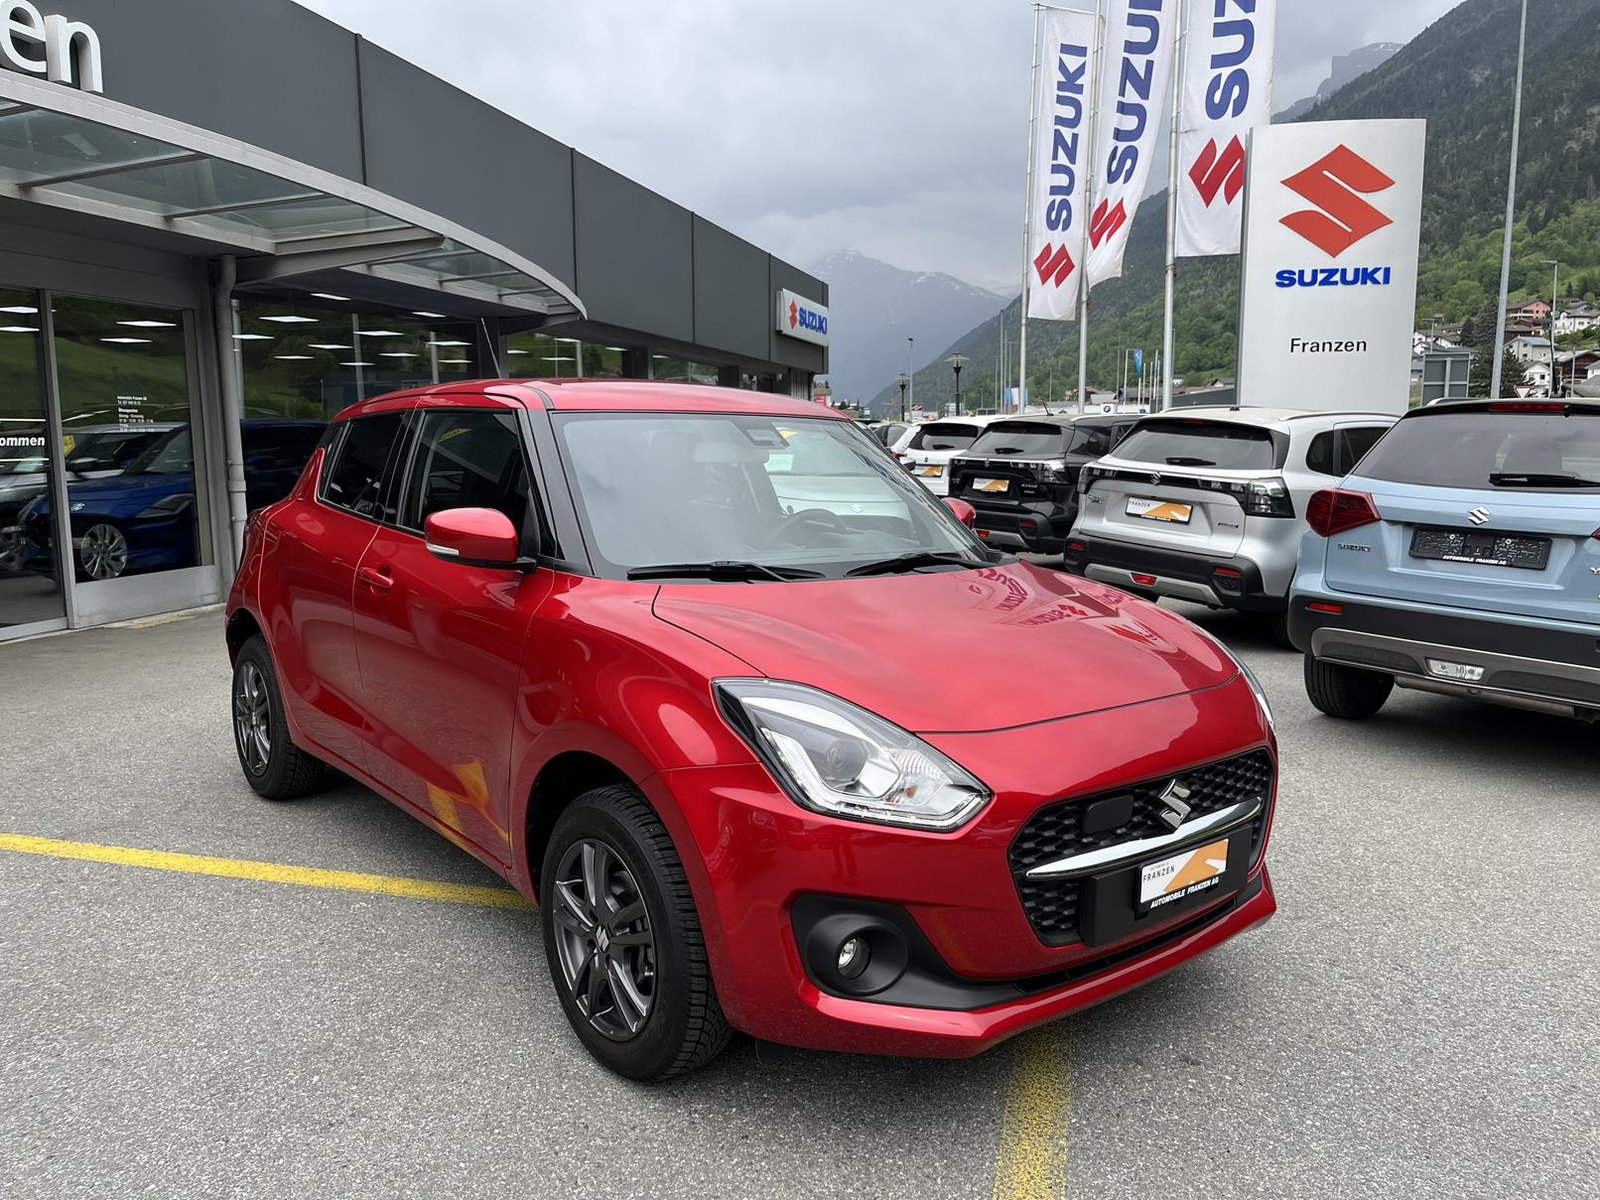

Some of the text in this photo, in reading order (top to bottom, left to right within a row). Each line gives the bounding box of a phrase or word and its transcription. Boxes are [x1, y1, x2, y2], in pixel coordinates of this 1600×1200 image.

[1046, 43, 1087, 232] SUZUKI
[1275, 266, 1391, 288] SUZUKI
[799, 307, 827, 335] SUZUKI
[1290, 337, 1367, 354] Franzen
[1143, 865, 1175, 883] FRANZEN
[1150, 876, 1219, 909] AUTOMOBILE FRANZEN AG
